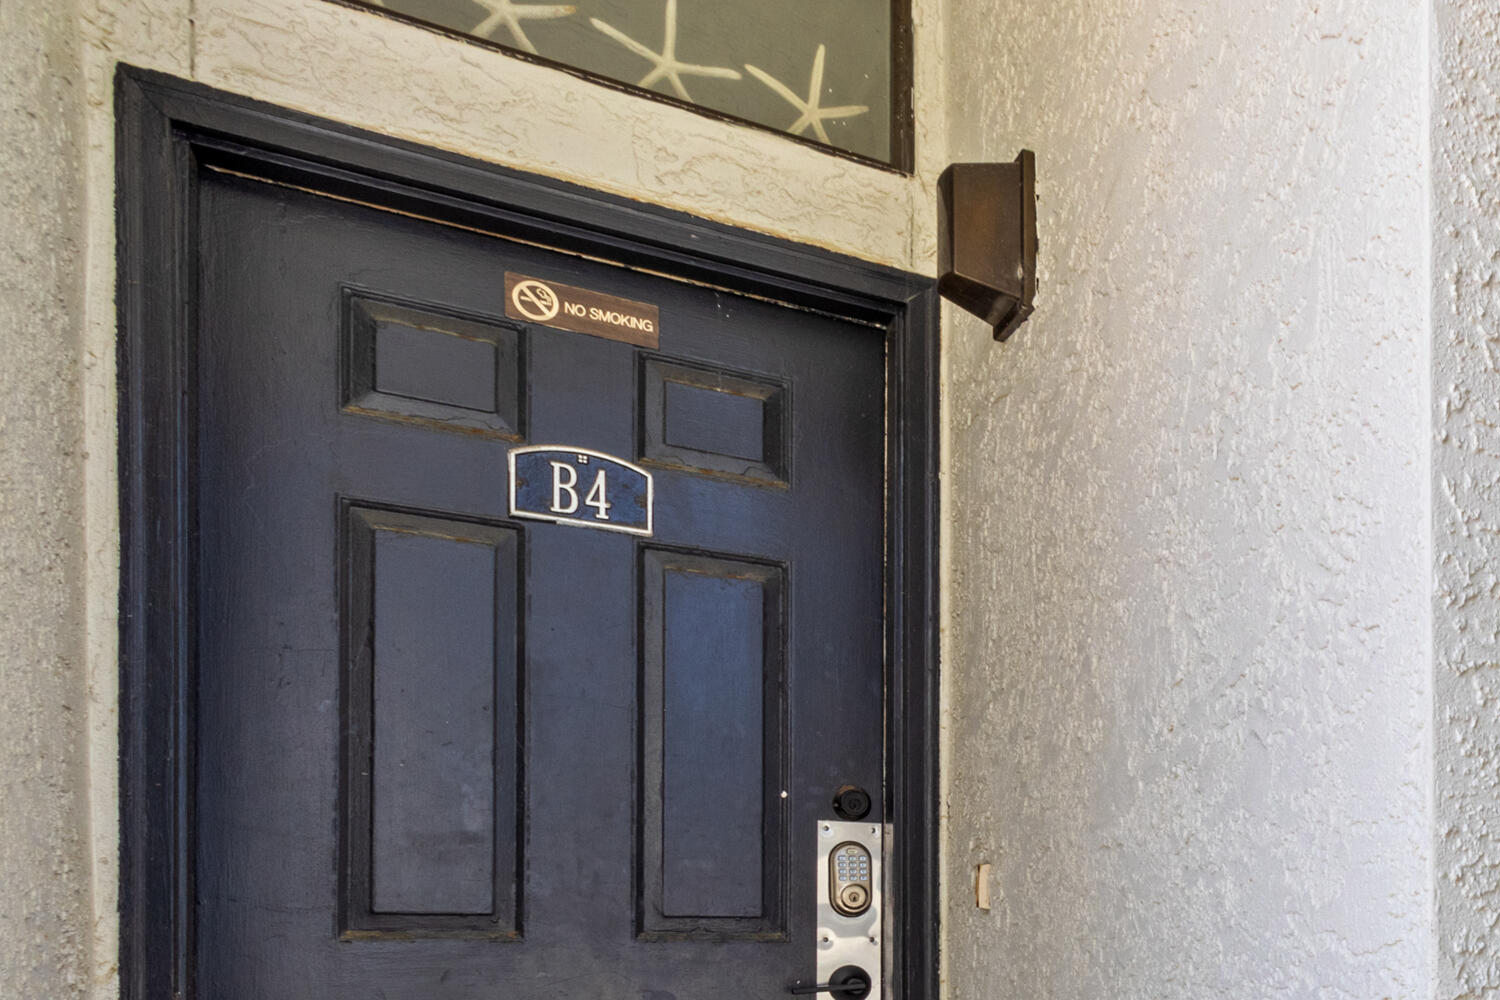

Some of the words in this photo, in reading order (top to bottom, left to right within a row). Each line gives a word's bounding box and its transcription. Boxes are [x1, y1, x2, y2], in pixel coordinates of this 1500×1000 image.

[564, 301, 586, 317] NO
[589, 307, 653, 332] SMOKING
[550, 461, 611, 519] B4
